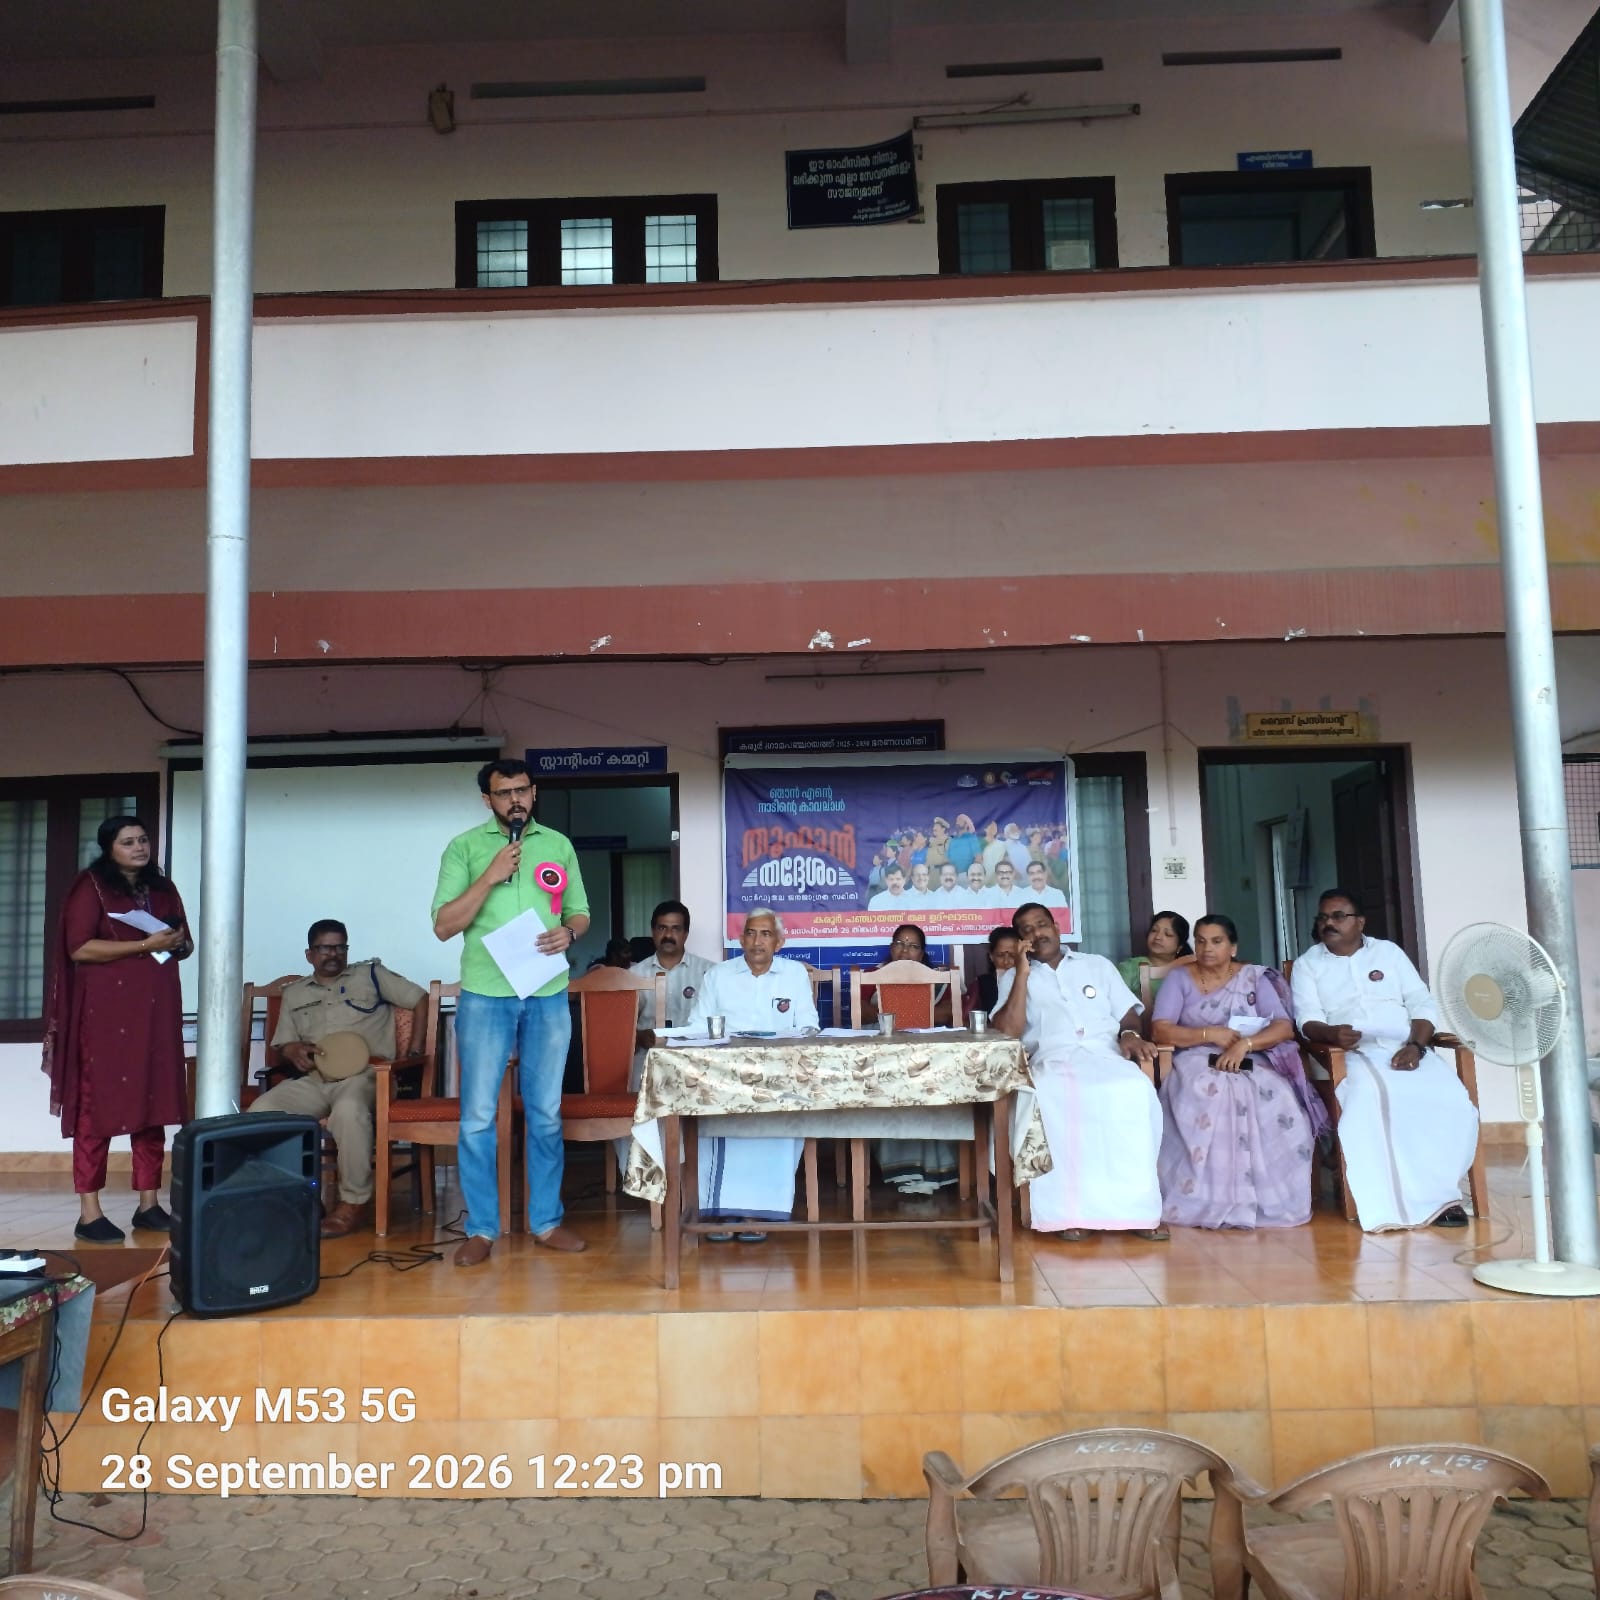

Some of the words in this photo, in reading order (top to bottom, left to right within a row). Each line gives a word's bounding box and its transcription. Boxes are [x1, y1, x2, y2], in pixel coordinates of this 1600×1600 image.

[770, 786, 800, 799] ഞാൻ
[799, 798, 846, 812] കാവലാൾ
[759, 855, 837, 894] തദ്ദേശം
